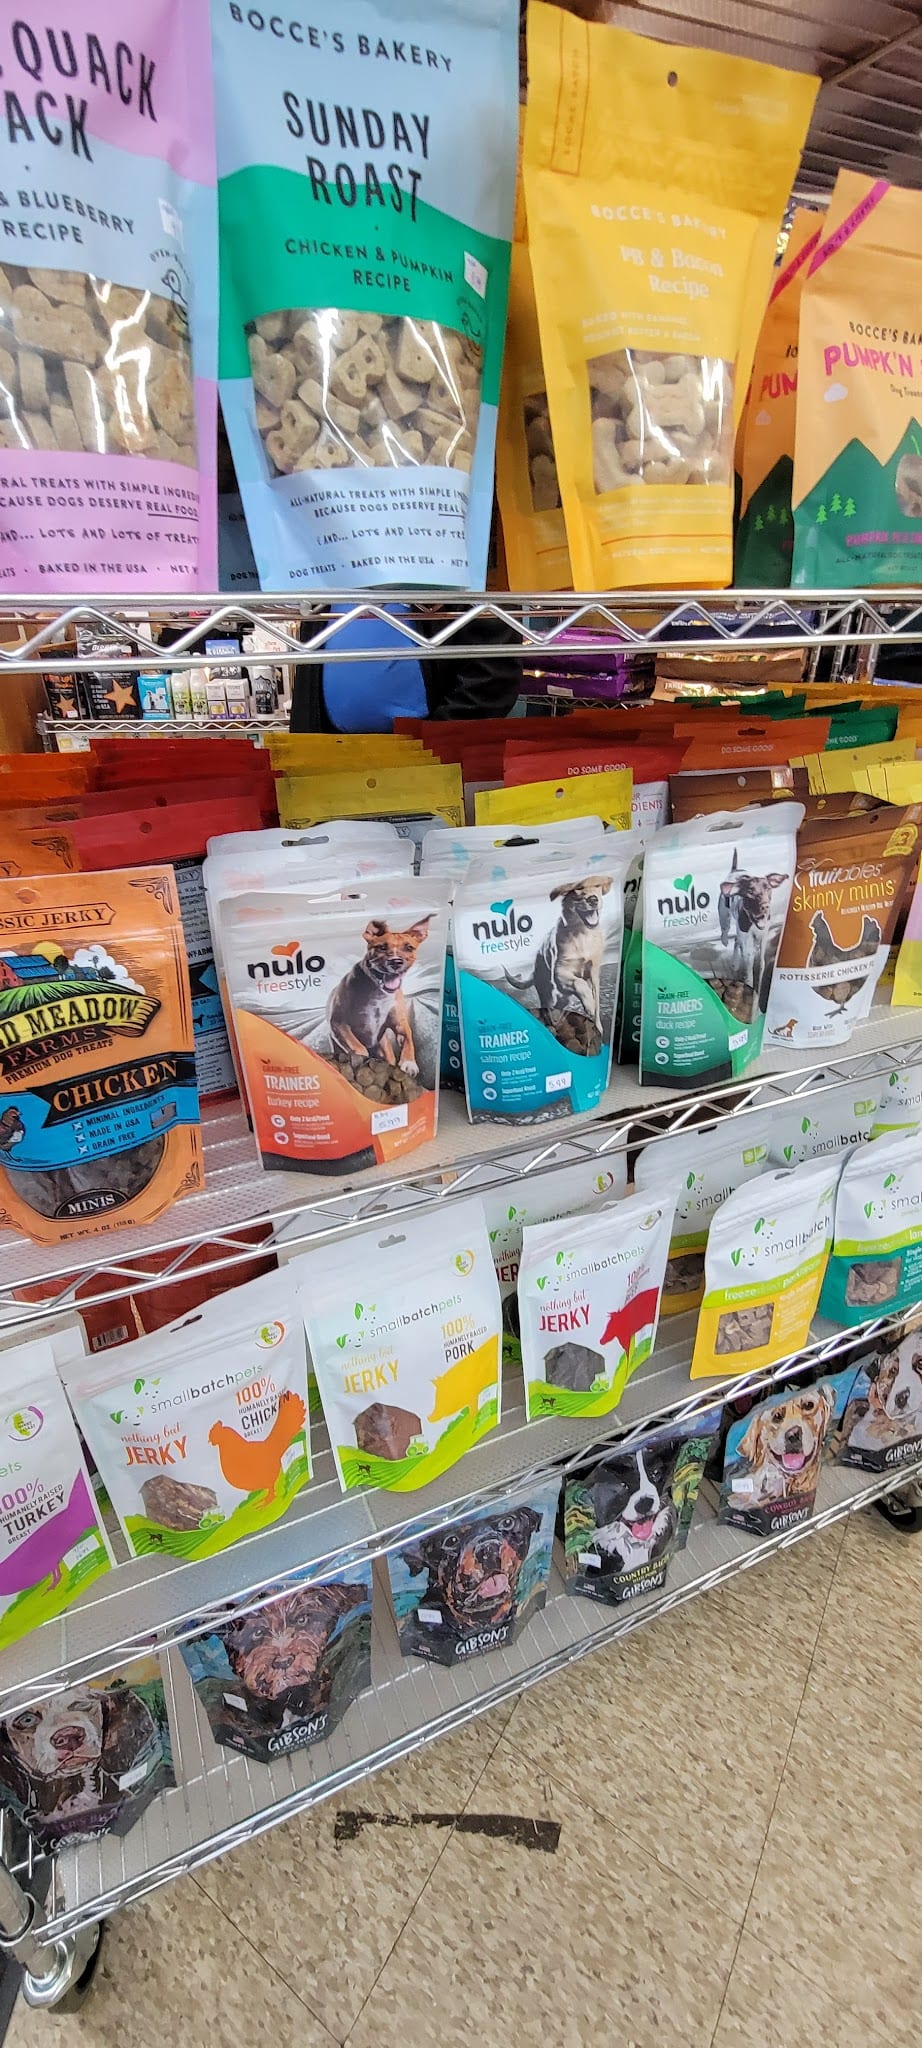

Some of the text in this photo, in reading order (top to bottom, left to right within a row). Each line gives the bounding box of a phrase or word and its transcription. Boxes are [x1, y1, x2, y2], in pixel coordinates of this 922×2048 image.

[229, 2, 453, 74] BOCCE'S BAKERY
[12, 20, 158, 123] QUACK
[282, 90, 431, 160] SUNDAY
[306, 155, 423, 223] ROAST
[18, 190, 134, 235] BLUEBERRY
[3, 220, 84, 244] RECIPE
[285, 238, 455, 283] CHICKEN & PUMPKIN
[651, 247, 665, 268] &
[353, 269, 411, 292] RECIPE
[648, 274, 710, 300] Recipe
[849, 320, 898, 343] BOCCE'S
[824, 341, 914, 378] PUMPK'N
[31, 477, 80, 490] TREATS
[83, 480, 116, 492] WITH
[120, 481, 163, 496] SIMPLE
[349, 489, 386, 500] TREATS
[389, 488, 416, 499] WITH
[419, 487, 451, 498] SIMPLE
[48, 496, 84, 508] DOGS
[89, 497, 143, 511] DESERVE
[147, 502, 172, 514] REAL
[314, 501, 460, 518] BECAUSE DOGS DESERVE REAL
[82, 528, 106, 540] AND
[146, 531, 160, 542] OF
[384, 526, 404, 537] AND
[435, 528, 447, 538] OF
[38, 563, 80, 575] BAKED
[84, 563, 97, 574] IN
[101, 563, 123, 574] THE
[126, 563, 147, 574] USA
[289, 566, 309, 579] DOG
[311, 564, 336, 576] TREATS
[351, 556, 382, 569] BAKED
[399, 556, 416, 565] THE
[568, 767, 579, 776] DO
[604, 763, 627, 772] GOOD
[809, 863, 881, 889] fruitables
[658, 885, 711, 916] nulo
[792, 885, 844, 914] skinny
[849, 879, 895, 902] minis
[41, 908, 106, 926] JERKY
[472, 908, 533, 941] nulo
[663, 911, 708, 929] freestyle
[480, 934, 532, 955] freestyle
[247, 949, 326, 980] nulo
[779, 969, 835, 982] ROTISSERIE
[837, 963, 868, 977] CHICKEN
[256, 975, 322, 995] freestyle
[25, 997, 141, 1035] MEADOW
[657, 998, 704, 1015] TRAINERS
[8, 1027, 98, 1067] FARMS
[478, 1030, 530, 1049] TRAINERS
[4, 1038, 114, 1085] PREMIUM DOG TREATS
[480, 1050, 532, 1064] salmon recipe
[53, 1060, 177, 1113] CHICKEN
[264, 1075, 321, 1092] TRAINERS
[86, 1110, 121, 1127] MINIMAL
[89, 1118, 141, 1138] MADE IN USA
[118, 1132, 136, 1144] FREE
[68, 1194, 116, 1216] MINIS
[539, 1297, 573, 1313] nothing
[441, 1312, 475, 1339] 100%
[538, 1304, 590, 1333] JERKY
[445, 1341, 476, 1363] PORK
[343, 1359, 400, 1395] JERKY
[235, 1374, 277, 1407] 100%
[120, 1421, 182, 1446] nothing but
[126, 1435, 188, 1467] JERKY
[38, 1483, 64, 1504] RAISED
[3, 1490, 66, 1537] TURKEY
[8, 1528, 32, 1545] BREAST
[613, 1564, 650, 1585] COUNTRY
